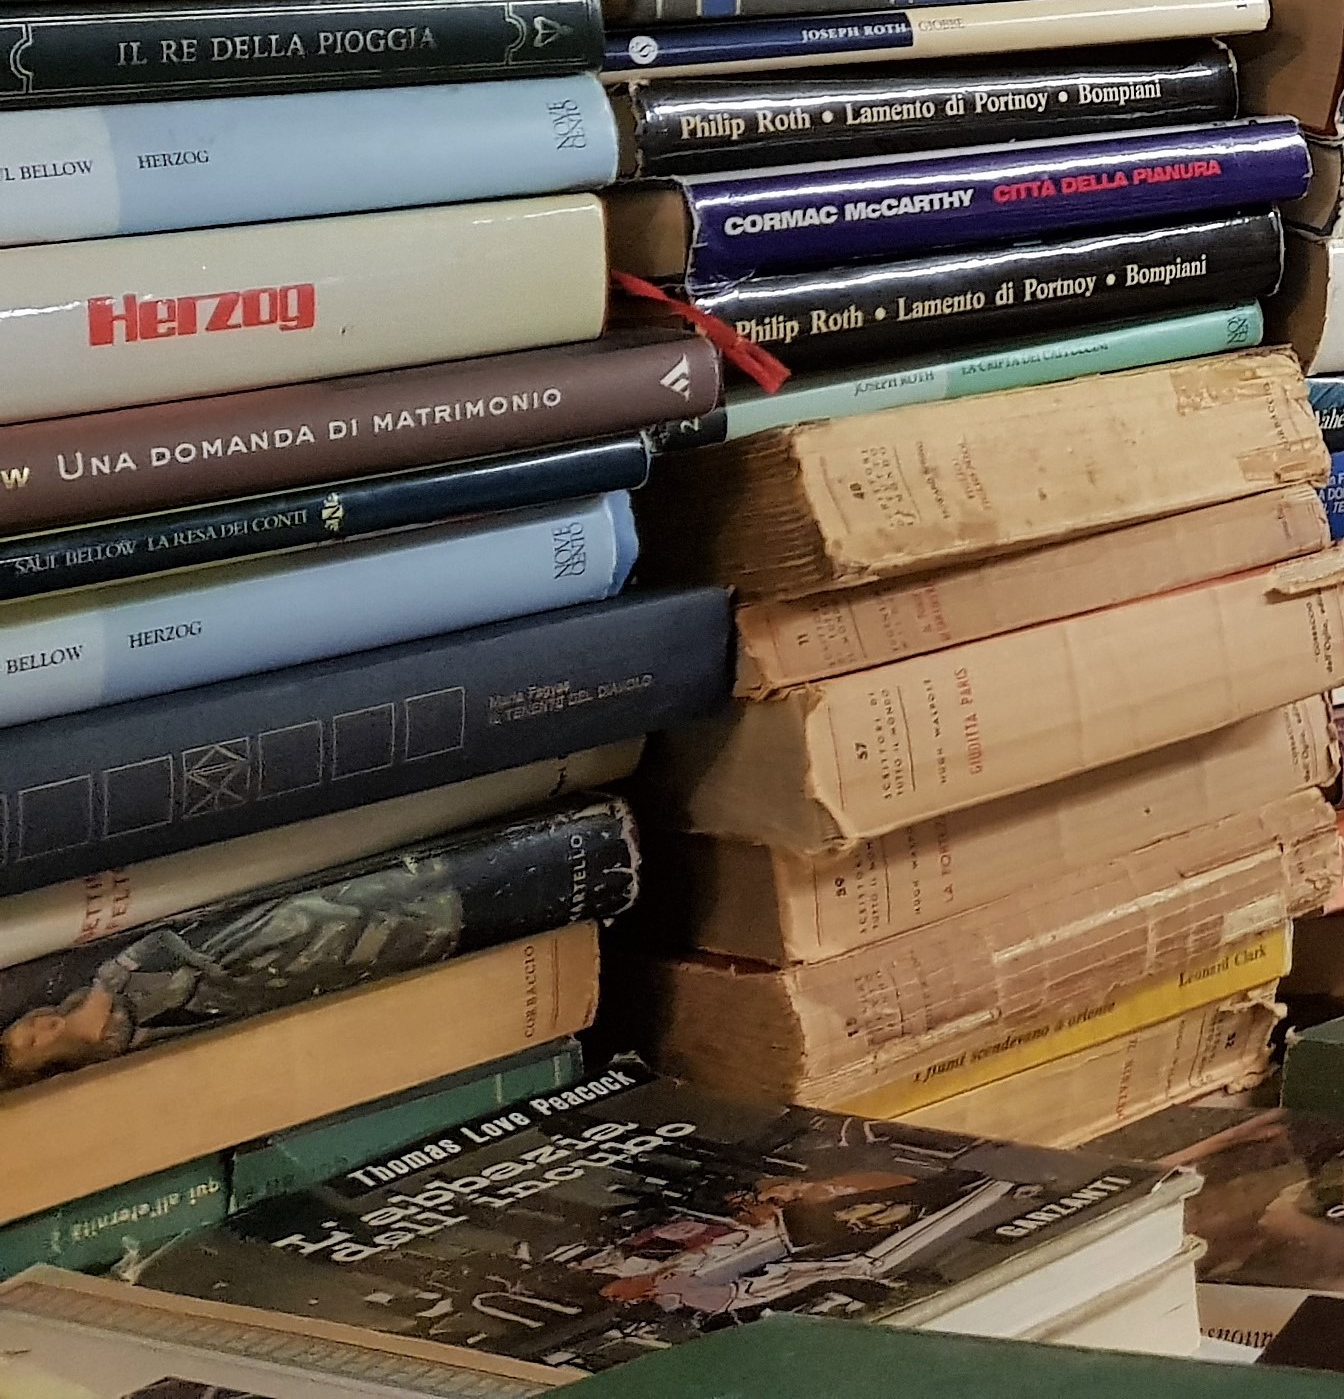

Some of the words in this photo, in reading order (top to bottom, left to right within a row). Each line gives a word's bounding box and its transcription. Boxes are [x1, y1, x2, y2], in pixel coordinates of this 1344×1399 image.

[117, 41, 146, 67] IL
[160, 38, 197, 63] RE
[318, 27, 437, 55] PIOGGIA
[680, 111, 745, 140] Philip
[758, 110, 810, 133] Roth
[846, 96, 935, 127] Lamento
[946, 93, 965, 117] di
[975, 90, 1048, 117] Portnoy
[1079, 80, 1161, 107] Bompiani
[724, 203, 838, 237] CORMAC
[1131, 160, 1221, 188] PIANURA
[87, 283, 316, 347] Herzog
[58, 449, 136, 481] UNA
[150, 427, 315, 467] DOMANDA
[329, 418, 358, 440] DI
[374, 388, 561, 432] MATRIMONIO
[347, 1142, 461, 1189] Thomas
[461, 1110, 529, 1149] Love
[529, 1068, 636, 1120] Peacock
[995, 1176, 1131, 1238] GARZANTI
